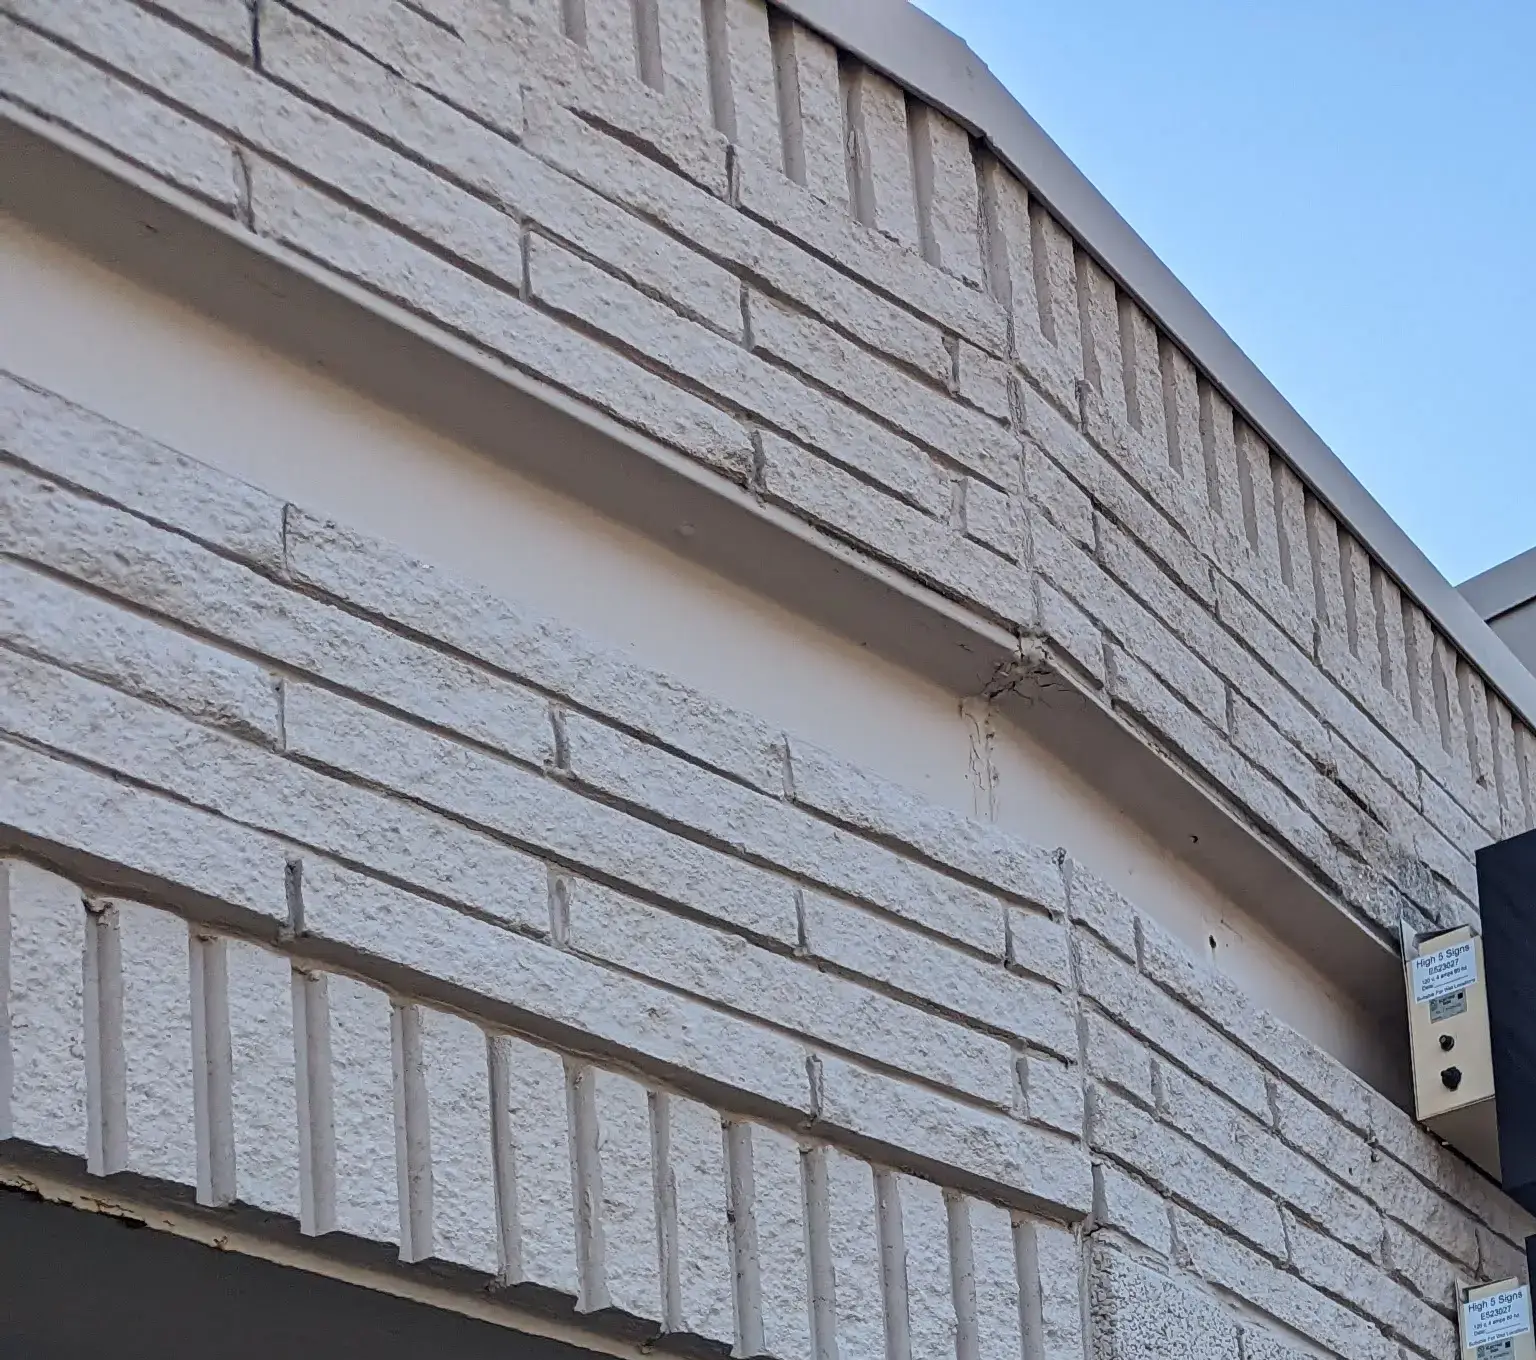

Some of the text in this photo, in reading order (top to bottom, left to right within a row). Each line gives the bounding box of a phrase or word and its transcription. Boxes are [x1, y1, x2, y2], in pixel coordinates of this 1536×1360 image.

[1415, 955, 1436, 970] High
[1446, 944, 1470, 958] Signs
[1468, 1300, 1488, 1314] High
[1498, 1291, 1523, 1305] Signs
